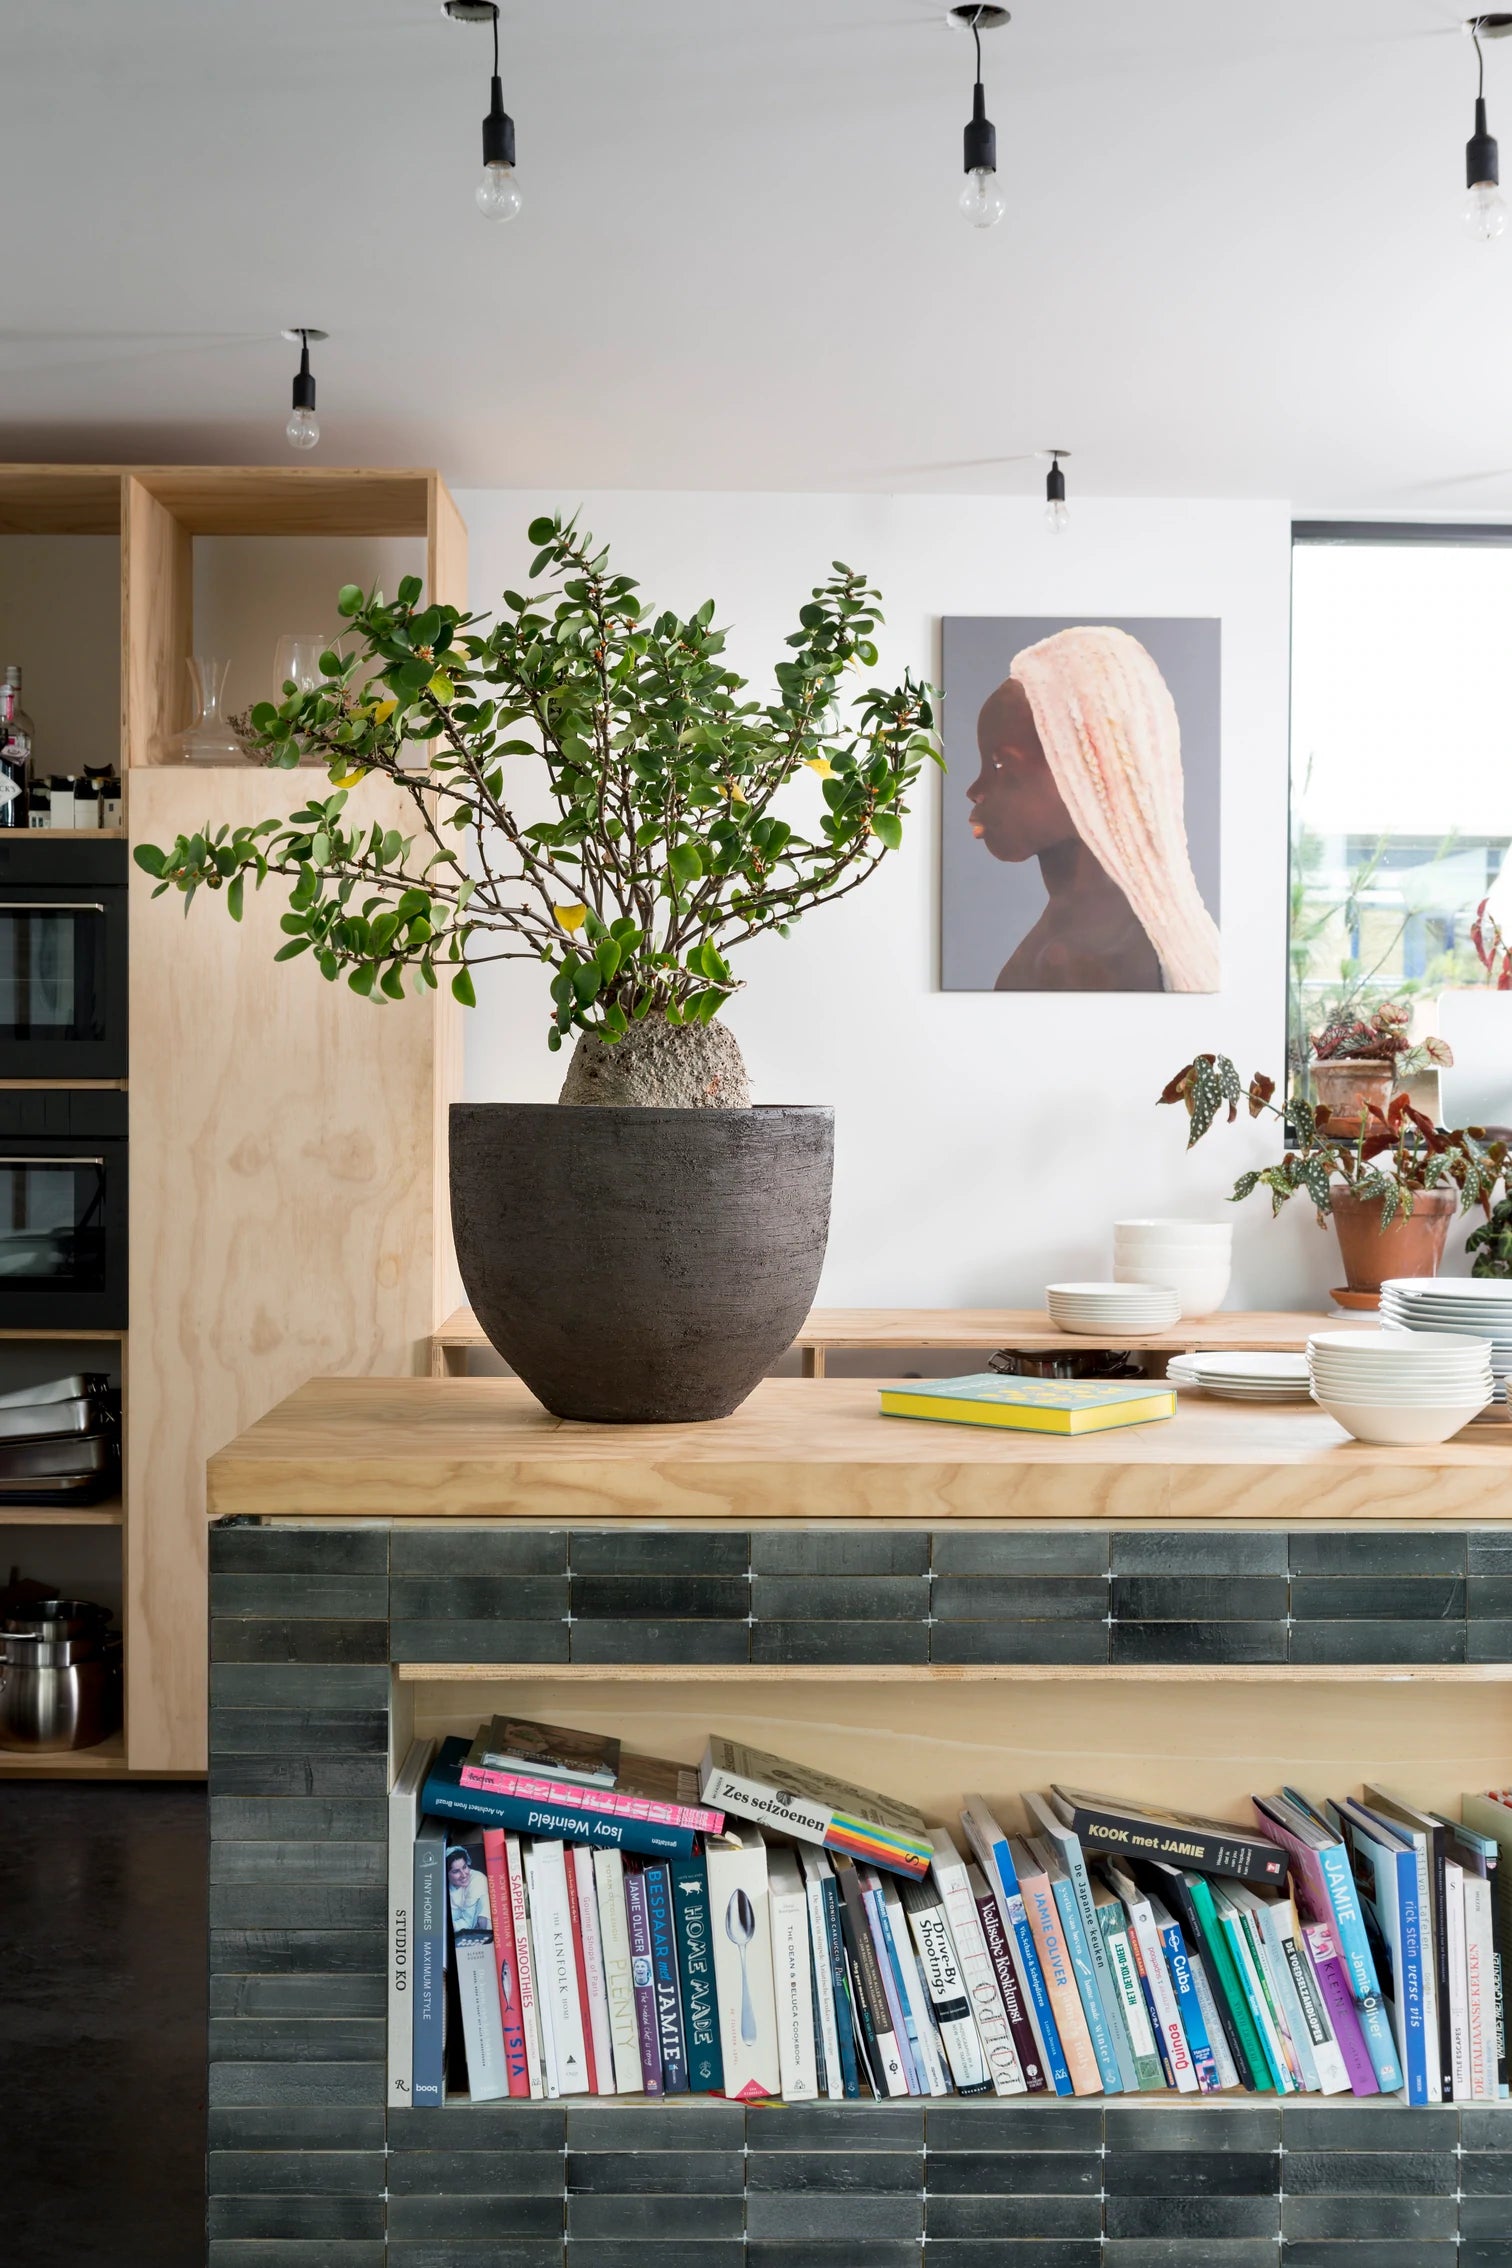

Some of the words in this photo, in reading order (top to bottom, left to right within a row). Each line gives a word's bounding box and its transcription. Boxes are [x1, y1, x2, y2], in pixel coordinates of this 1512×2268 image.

[435, 1798, 453, 1808] Brazil
[454, 1800, 468, 1809] from
[468, 1803, 496, 1815] Architect
[495, 1809, 505, 1817] An
[723, 1785, 749, 1804] Zes
[751, 1797, 826, 1832] seizoenen
[528, 1811, 589, 1837] Weinfeld
[598, 1822, 622, 1842] Isay
[651, 1838, 678, 1849] gestalten
[1088, 1824, 1129, 1844] KOOK
[1131, 1834, 1160, 1849] met
[1160, 1839, 1206, 1859] JAMIE
[423, 1873, 433, 1895] TINY
[499, 1872, 508, 1902] BLACK
[1073, 1863, 1083, 1879] De
[488, 1874, 498, 1915] GRIGSON
[510, 1874, 526, 1921] SAPPEN
[629, 1879, 641, 1912] JAMIE
[812, 1894, 820, 1906] De
[827, 1891, 837, 1922] ANTONIO
[875, 1890, 889, 1918] bouillon!
[1077, 1881, 1094, 1926] Japanse
[423, 1896, 433, 1931] HOMES
[502, 1903, 512, 1939] WILLIAM
[583, 1896, 594, 1932] Gourmet
[648, 1870, 670, 1957] BESPAAR
[1404, 1900, 1418, 1924] rick
[1419, 1904, 1431, 1951] tafelen
[395, 1909, 407, 1966] STUDIO
[632, 1914, 645, 1953] OLIVER
[684, 1904, 708, 1975] HOME
[831, 1923, 841, 1962] CARLUCCIO
[981, 1901, 1006, 1957] Vedische
[1034, 1892, 1054, 1933] JAMIE
[1046, 1935, 1067, 1988] OLIVER
[1406, 1926, 1420, 1958] stein
[552, 1932, 569, 1995] KINFOLK
[586, 1935, 598, 1961] Shops
[919, 1920, 946, 1995] Shootings
[932, 1920, 957, 1986] Drive-By
[1090, 1928, 1106, 1969] keuken
[1284, 1940, 1296, 1954] DE
[1324, 1859, 1357, 1925] JAMIE
[1350, 1950, 1372, 1994] Jamie
[1363, 1996, 1383, 2040] Oliver
[395, 1969, 407, 1992] KO
[423, 1941, 432, 1990] MAXIMUM
[517, 1936, 534, 2009] SMOOTHIES
[589, 1964, 597, 1974] of
[657, 1960, 673, 1981] met
[834, 1967, 844, 1987] Pasta
[856, 1975, 864, 1987] per
[1114, 1943, 1135, 1990] DETOX-DIEET
[1173, 1954, 1191, 1996] Cuba
[1468, 1943, 1481, 1997] KEUKEN
[591, 1975, 600, 1998] Paris
[858, 1987, 868, 2009] maand
[874, 1981, 884, 2000] ALLES
[993, 1955, 1024, 2025] Kookkunst
[1029, 1966, 1046, 2008] Schelpdieren
[1083, 1978, 1095, 2000] home
[1125, 1990, 1138, 2006] HET
[1288, 1953, 1324, 2043] VOEDSELZANDLOPER
[1323, 1961, 1349, 2018] KLEINE
[1406, 1963, 1419, 2002] verse
[422, 1991, 432, 2021] STYLE
[560, 1998, 570, 2020] HOME
[608, 1959, 637, 2050] PLENTY
[690, 1978, 714, 2046] MADE
[788, 1945, 796, 1970] DEAN
[792, 2020, 801, 2067] COOKBOOK
[1087, 2000, 1100, 2022] made
[1150, 2006, 1160, 2029] CUBA
[1409, 2006, 1422, 2028] vis
[658, 1982, 681, 2061] JAMIE
[1470, 2000, 1484, 2075] ITALIAANSE
[1168, 2023, 1191, 2071] Quinoa
[1454, 2027, 1462, 2060] ESCAPES
[415, 2083, 438, 2094] booq
[930, 2066, 940, 2088] aperture
[1455, 2061, 1464, 2084] LITTLE
[1473, 2076, 1485, 2095] DE
